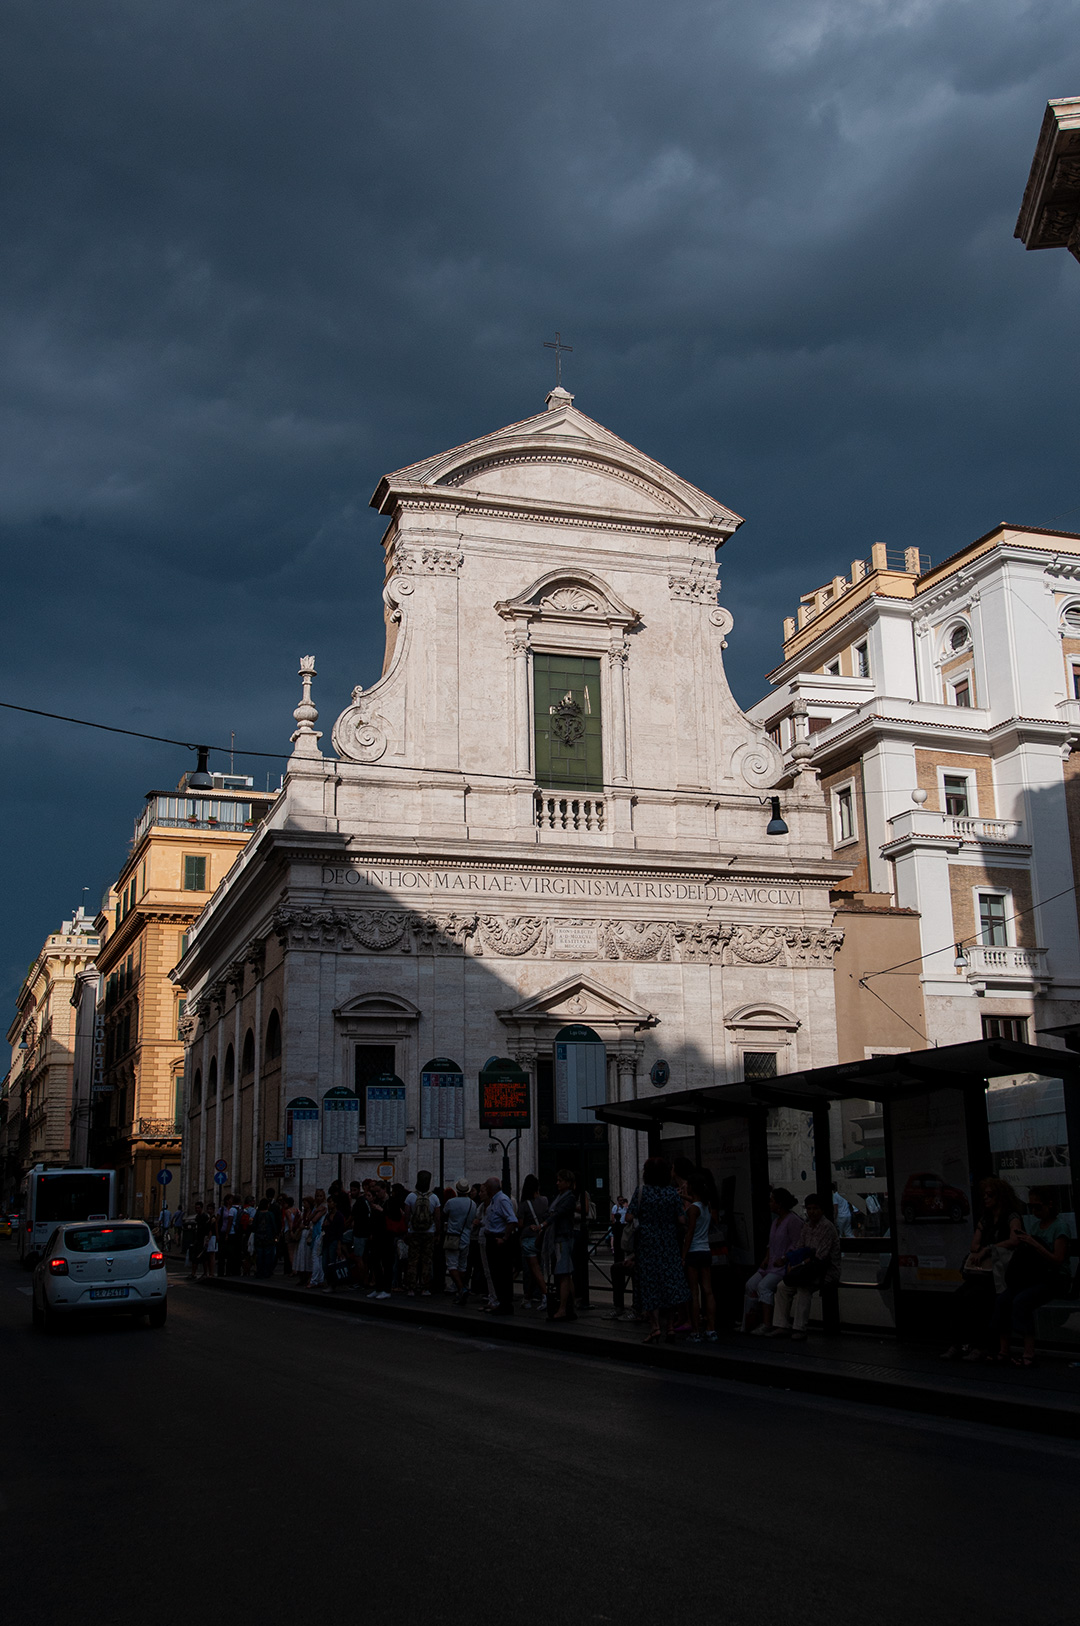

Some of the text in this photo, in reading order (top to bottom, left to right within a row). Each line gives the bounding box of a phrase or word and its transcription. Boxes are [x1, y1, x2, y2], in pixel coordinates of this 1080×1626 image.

[321, 869, 360, 885] DEO
[366, 870, 384, 886] IN
[389, 872, 430, 888] HON
[434, 873, 514, 892] MARIAE
[521, 876, 602, 896] VIRGINIS
[605, 880, 672, 899] MATRIS
[676, 884, 702, 900] DEI
[744, 888, 802, 905] MCCLVI
[1001, 1157, 1019, 1167] atac
